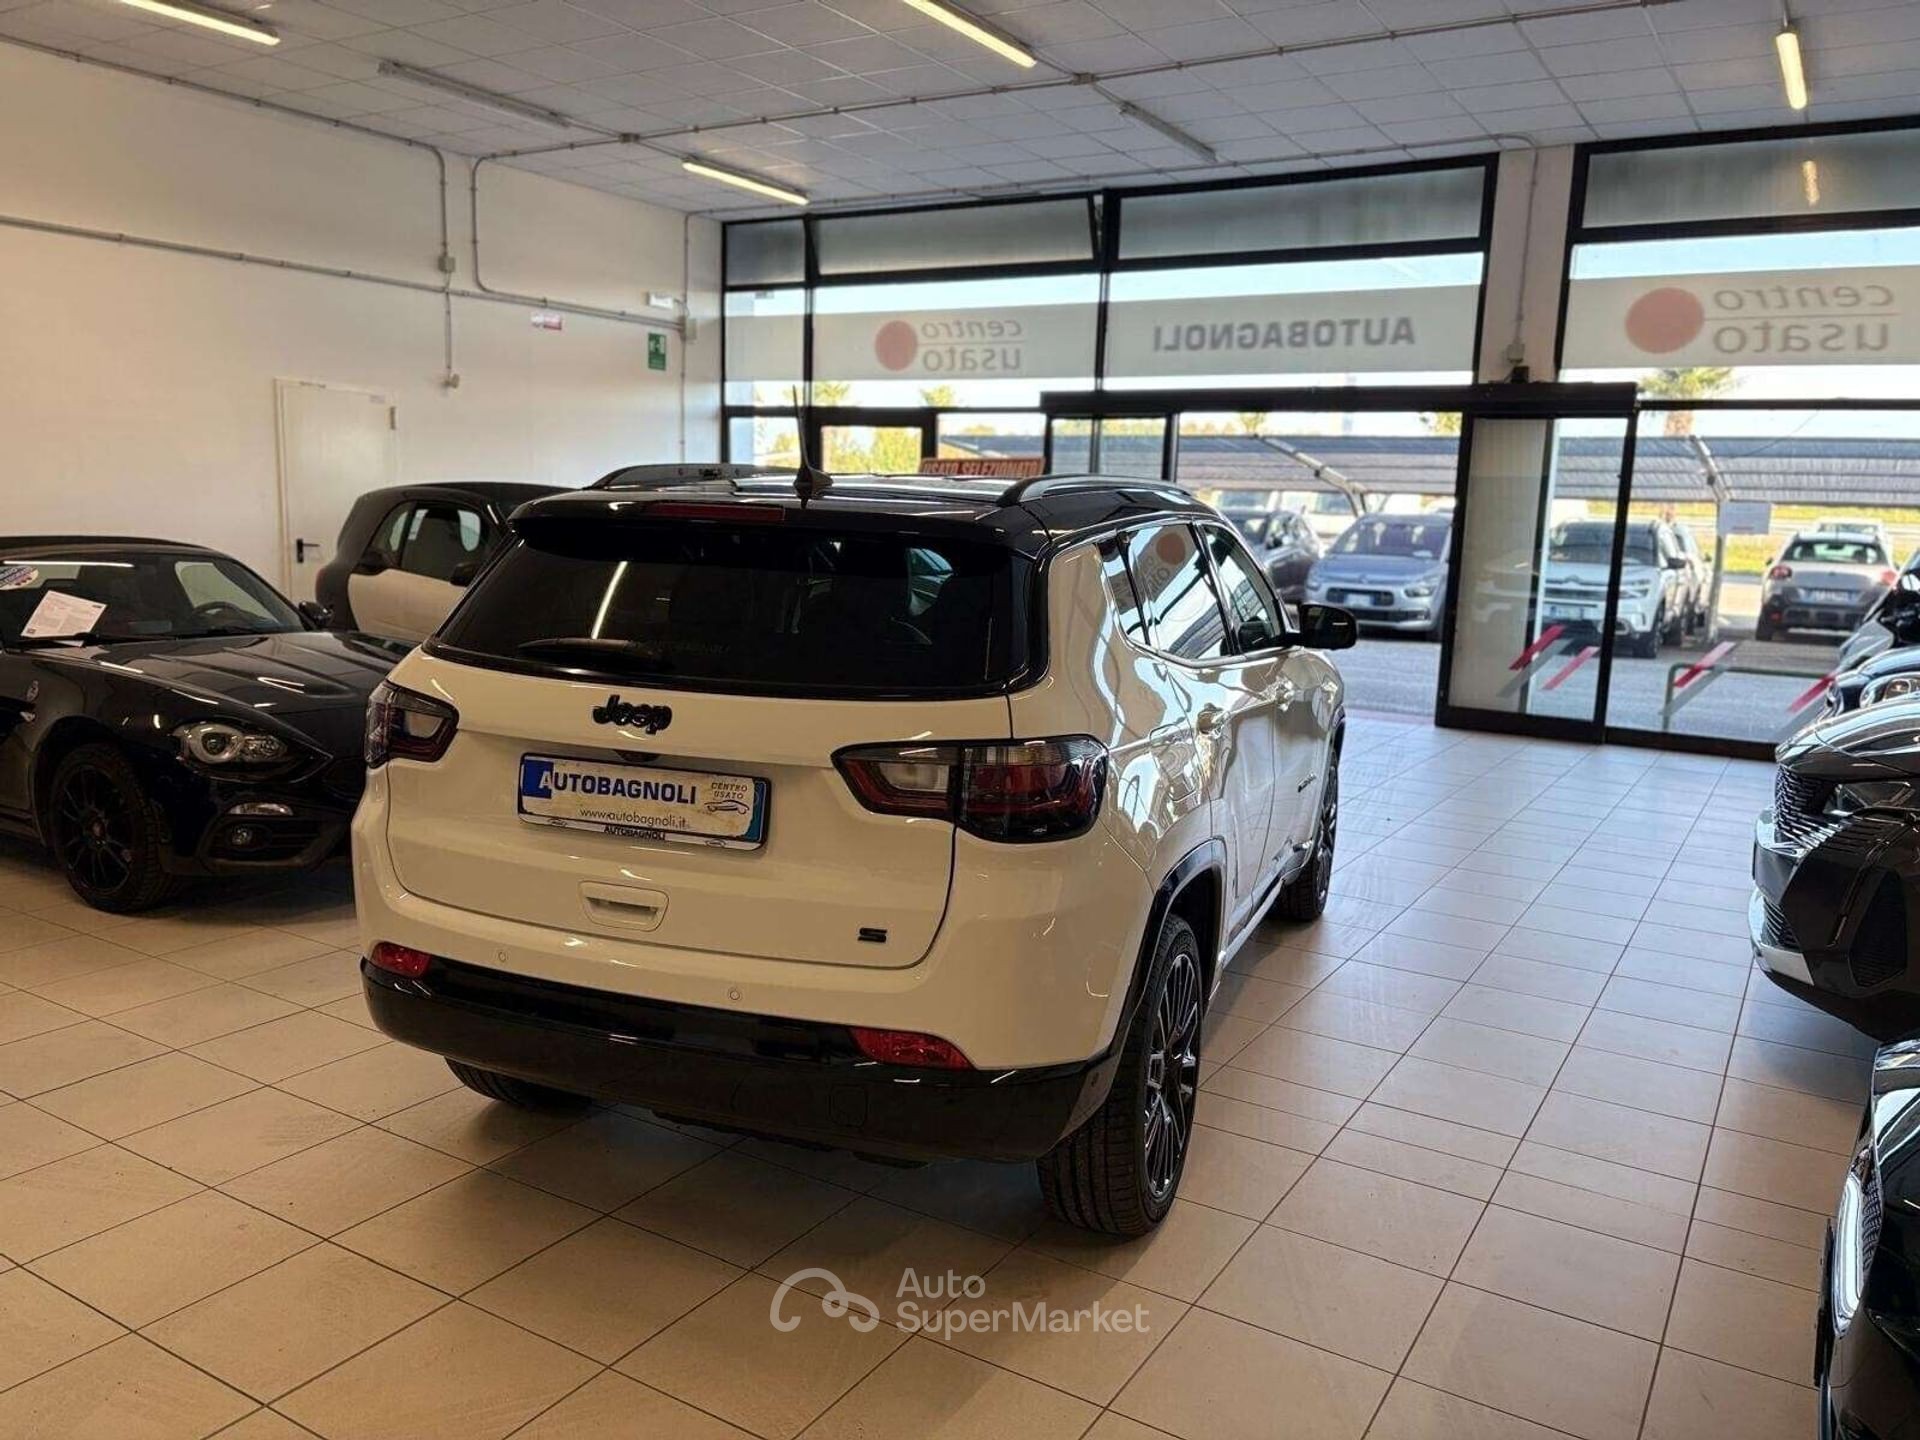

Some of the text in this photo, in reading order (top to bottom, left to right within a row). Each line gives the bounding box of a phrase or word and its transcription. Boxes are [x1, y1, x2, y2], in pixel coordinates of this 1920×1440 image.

[924, 461, 958, 474] USATO
[592, 694, 672, 735] Jeep
[540, 770, 696, 804] AUTOBAGNOLI
[711, 782, 748, 792] CENTRO
[713, 790, 744, 799] USATO
[580, 807, 688, 829] www.autobagnoli.it
[603, 825, 666, 841] AUTOBAGNOLI
